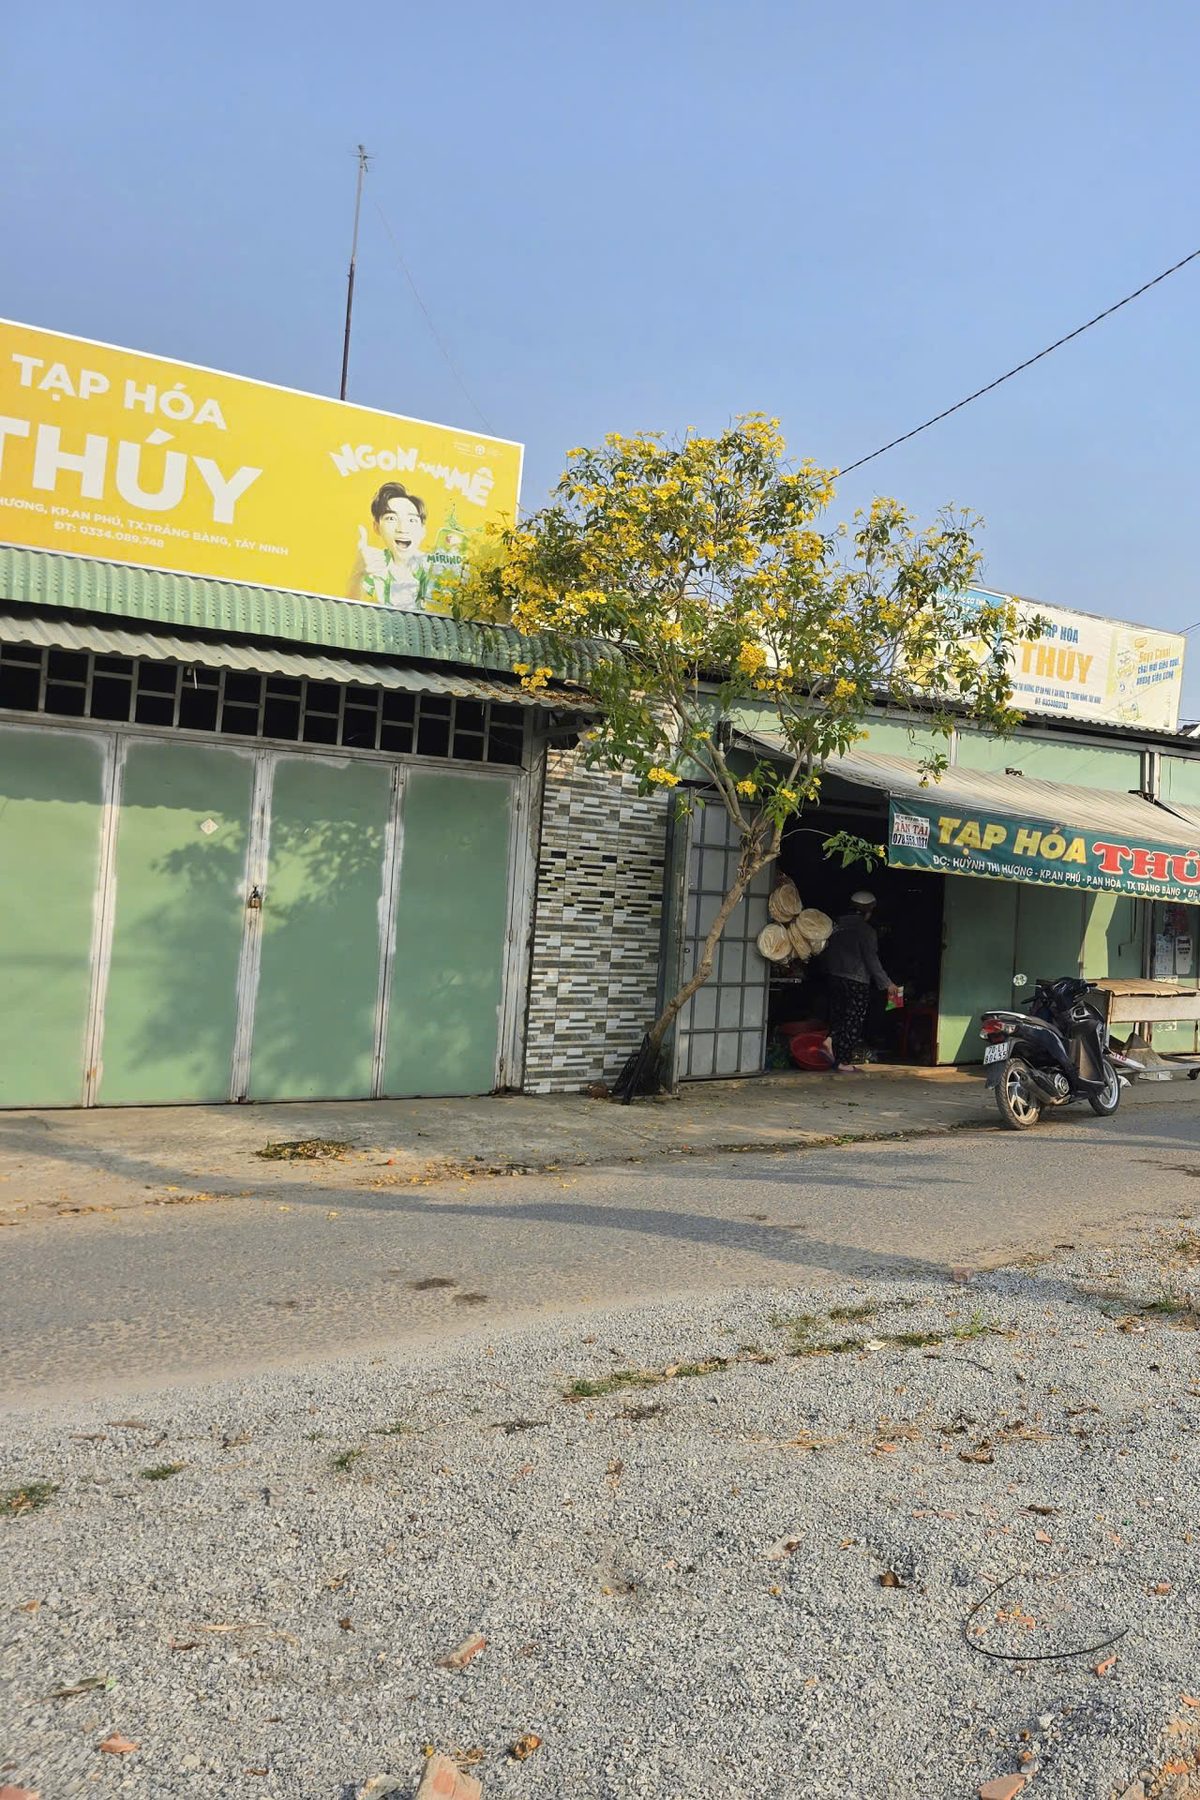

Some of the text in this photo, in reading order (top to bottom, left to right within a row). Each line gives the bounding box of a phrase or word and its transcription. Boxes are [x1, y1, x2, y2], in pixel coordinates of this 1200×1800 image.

[12, 353, 227, 431] TẠP HÓA
[330, 443, 419, 477] NGON
[259, 543, 289, 556] NINH
[1060, 624, 1079, 643] HÓA
[1020, 640, 1094, 684] THÚY
[938, 816, 1008, 855] TẠP
[1012, 826, 1087, 864] HÓA
[933, 855, 949, 866] ĐC:
[953, 857, 985, 871] HUỲNH
[987, 861, 1000, 875] THỊ
[1002, 863, 1033, 877] HƯƠNG
[1065, 867, 1081, 883] PHÚ
